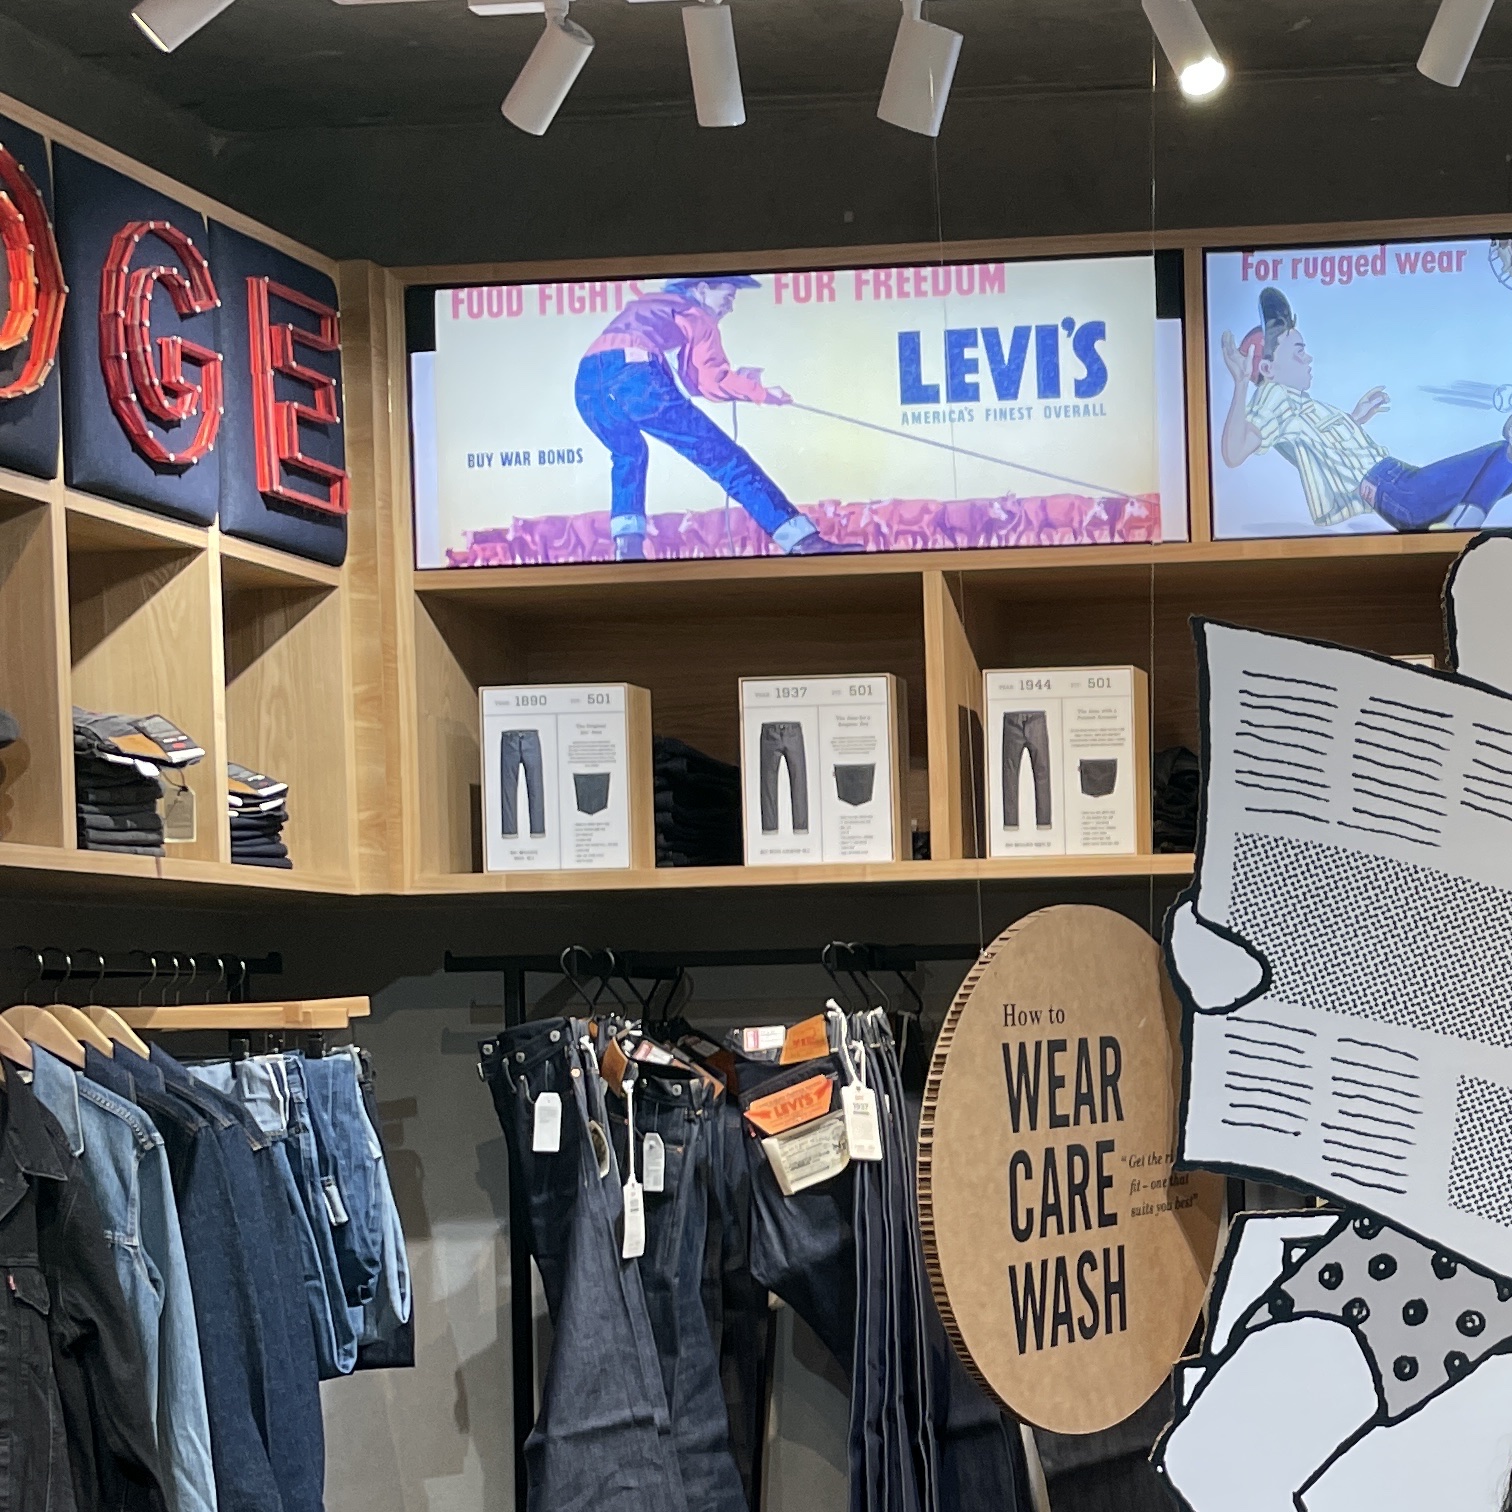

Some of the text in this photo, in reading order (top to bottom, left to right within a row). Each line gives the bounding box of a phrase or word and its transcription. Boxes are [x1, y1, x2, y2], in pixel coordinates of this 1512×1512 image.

[1241, 244, 1467, 286] For rugged wear
[452, 284, 523, 319] FOOD
[773, 271, 836, 304] FOR
[853, 263, 1006, 301] FREEDOM
[897, 316, 1109, 406] LEVI'S
[901, 403, 1107, 426] AMERICA'S FINEST OVERALL
[467, 448, 584, 469] BUY WAR BONDS
[775, 686, 807, 698] 1937
[849, 685, 873, 696] 501
[1019, 679, 1051, 690] 1944
[1088, 677, 1112, 688] 501
[515, 695, 547, 707] 1890
[587, 693, 611, 705] 501
[1002, 1003, 1066, 1028] How to
[1002, 1036, 1124, 1133] WEAR
[1147, 1151, 1163, 1166] the
[1009, 1139, 1118, 1243] CARE
[1150, 1178, 1167, 1190] one
[1131, 1201, 1154, 1217] suits
[1155, 1202, 1172, 1216] you
[1008, 1244, 1128, 1355] WASH
